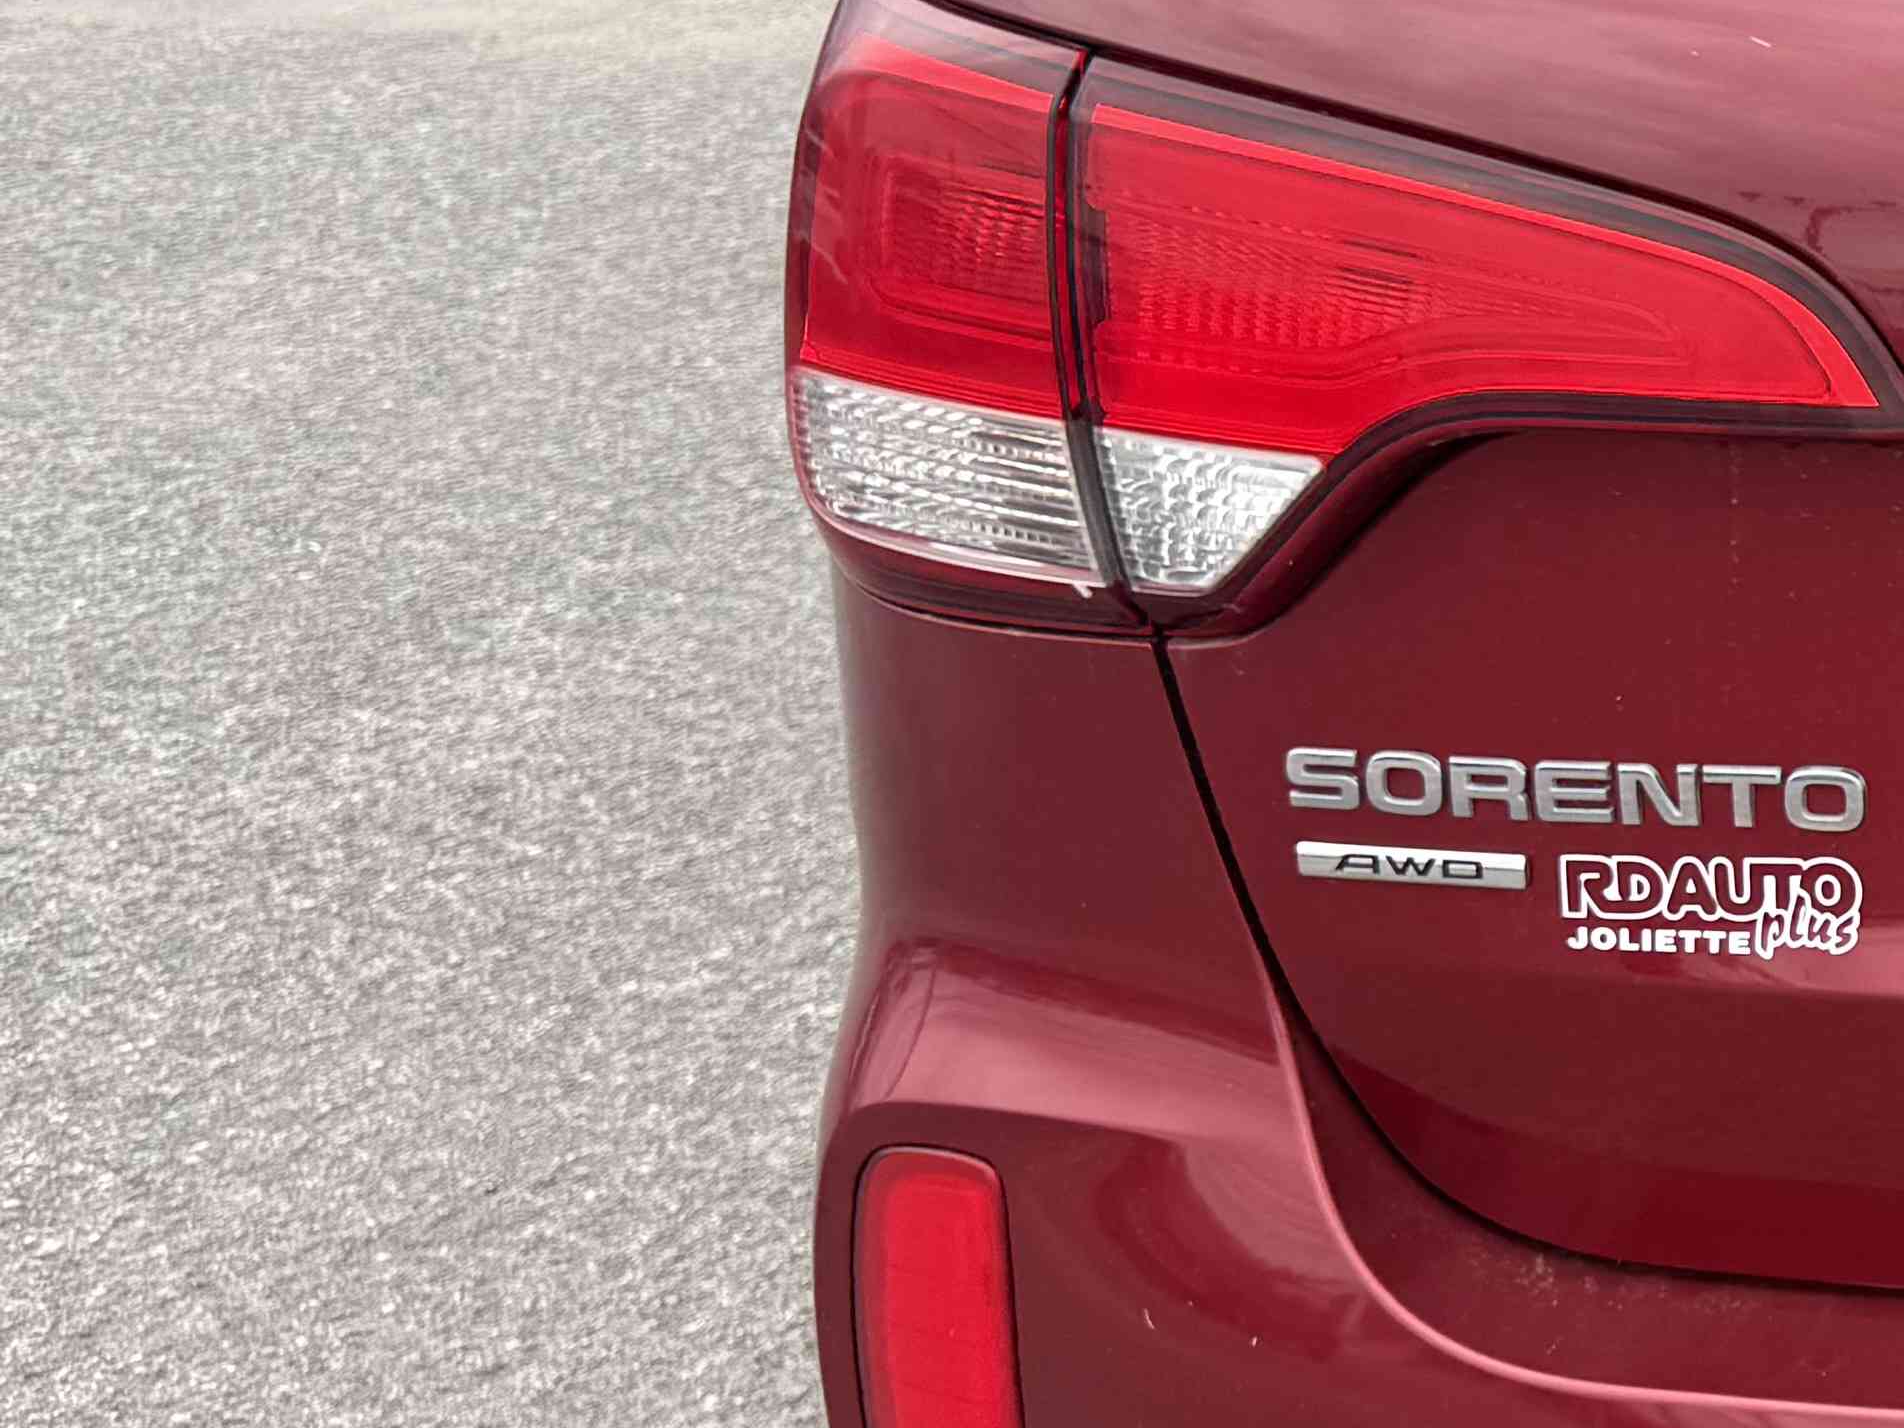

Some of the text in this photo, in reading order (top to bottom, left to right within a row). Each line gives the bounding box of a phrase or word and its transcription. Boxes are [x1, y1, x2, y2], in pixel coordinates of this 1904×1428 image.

[1285, 747, 1868, 832] SORENTO
[1335, 854, 1484, 879] AWD
[1567, 926, 1751, 954] JOLIETTE
[1754, 890, 1861, 960] plus
